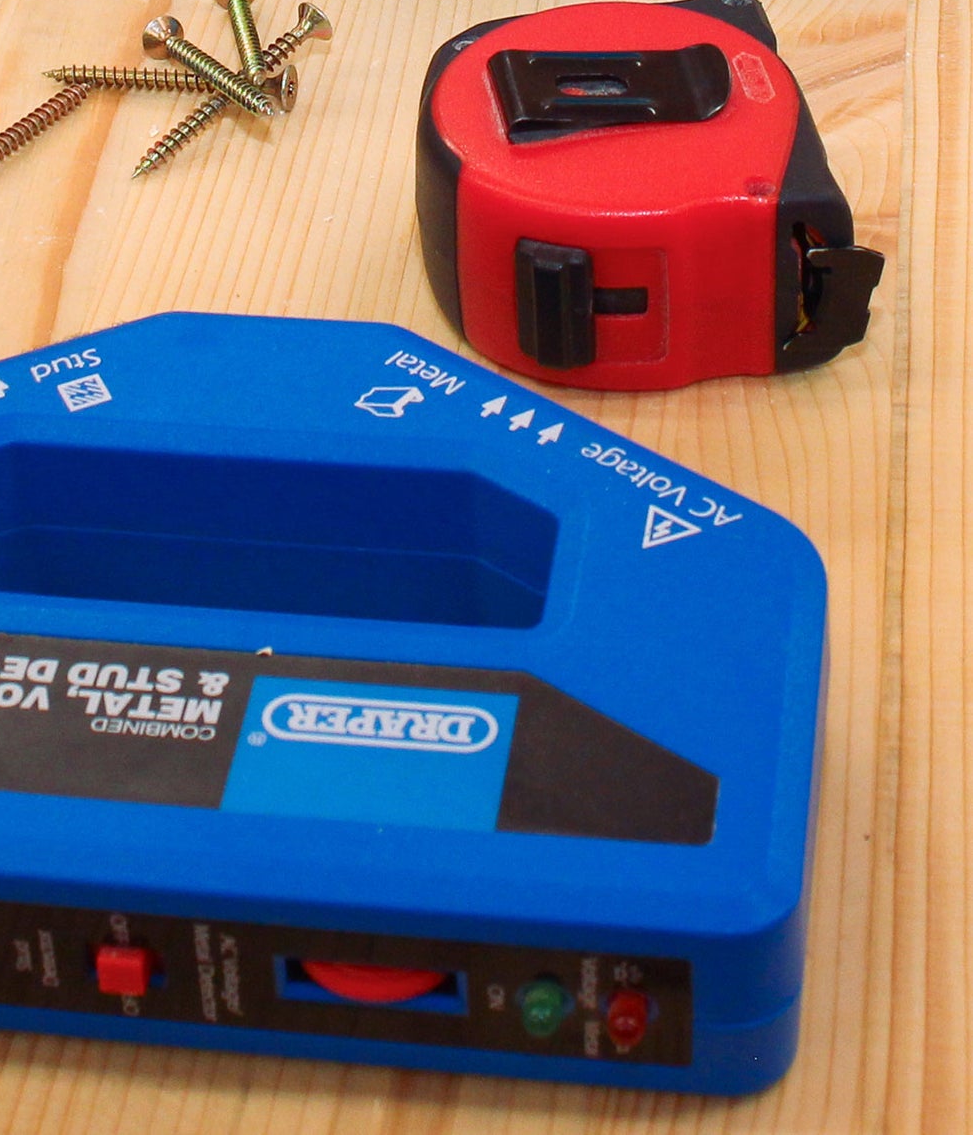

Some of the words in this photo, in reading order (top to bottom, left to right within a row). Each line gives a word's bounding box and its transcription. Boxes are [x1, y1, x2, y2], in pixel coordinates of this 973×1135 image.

[30, 347, 102, 383] Stud
[385, 349, 466, 396] Metal
[580, 442, 689, 508] Voltage
[689, 496, 743, 527] AC
[67, 661, 184, 694] STUD
[198, 671, 230, 697] &
[67, 685, 223, 725] METAL,
[90, 717, 216, 742] COMBINED
[286, 702, 476, 745] DRAPER
